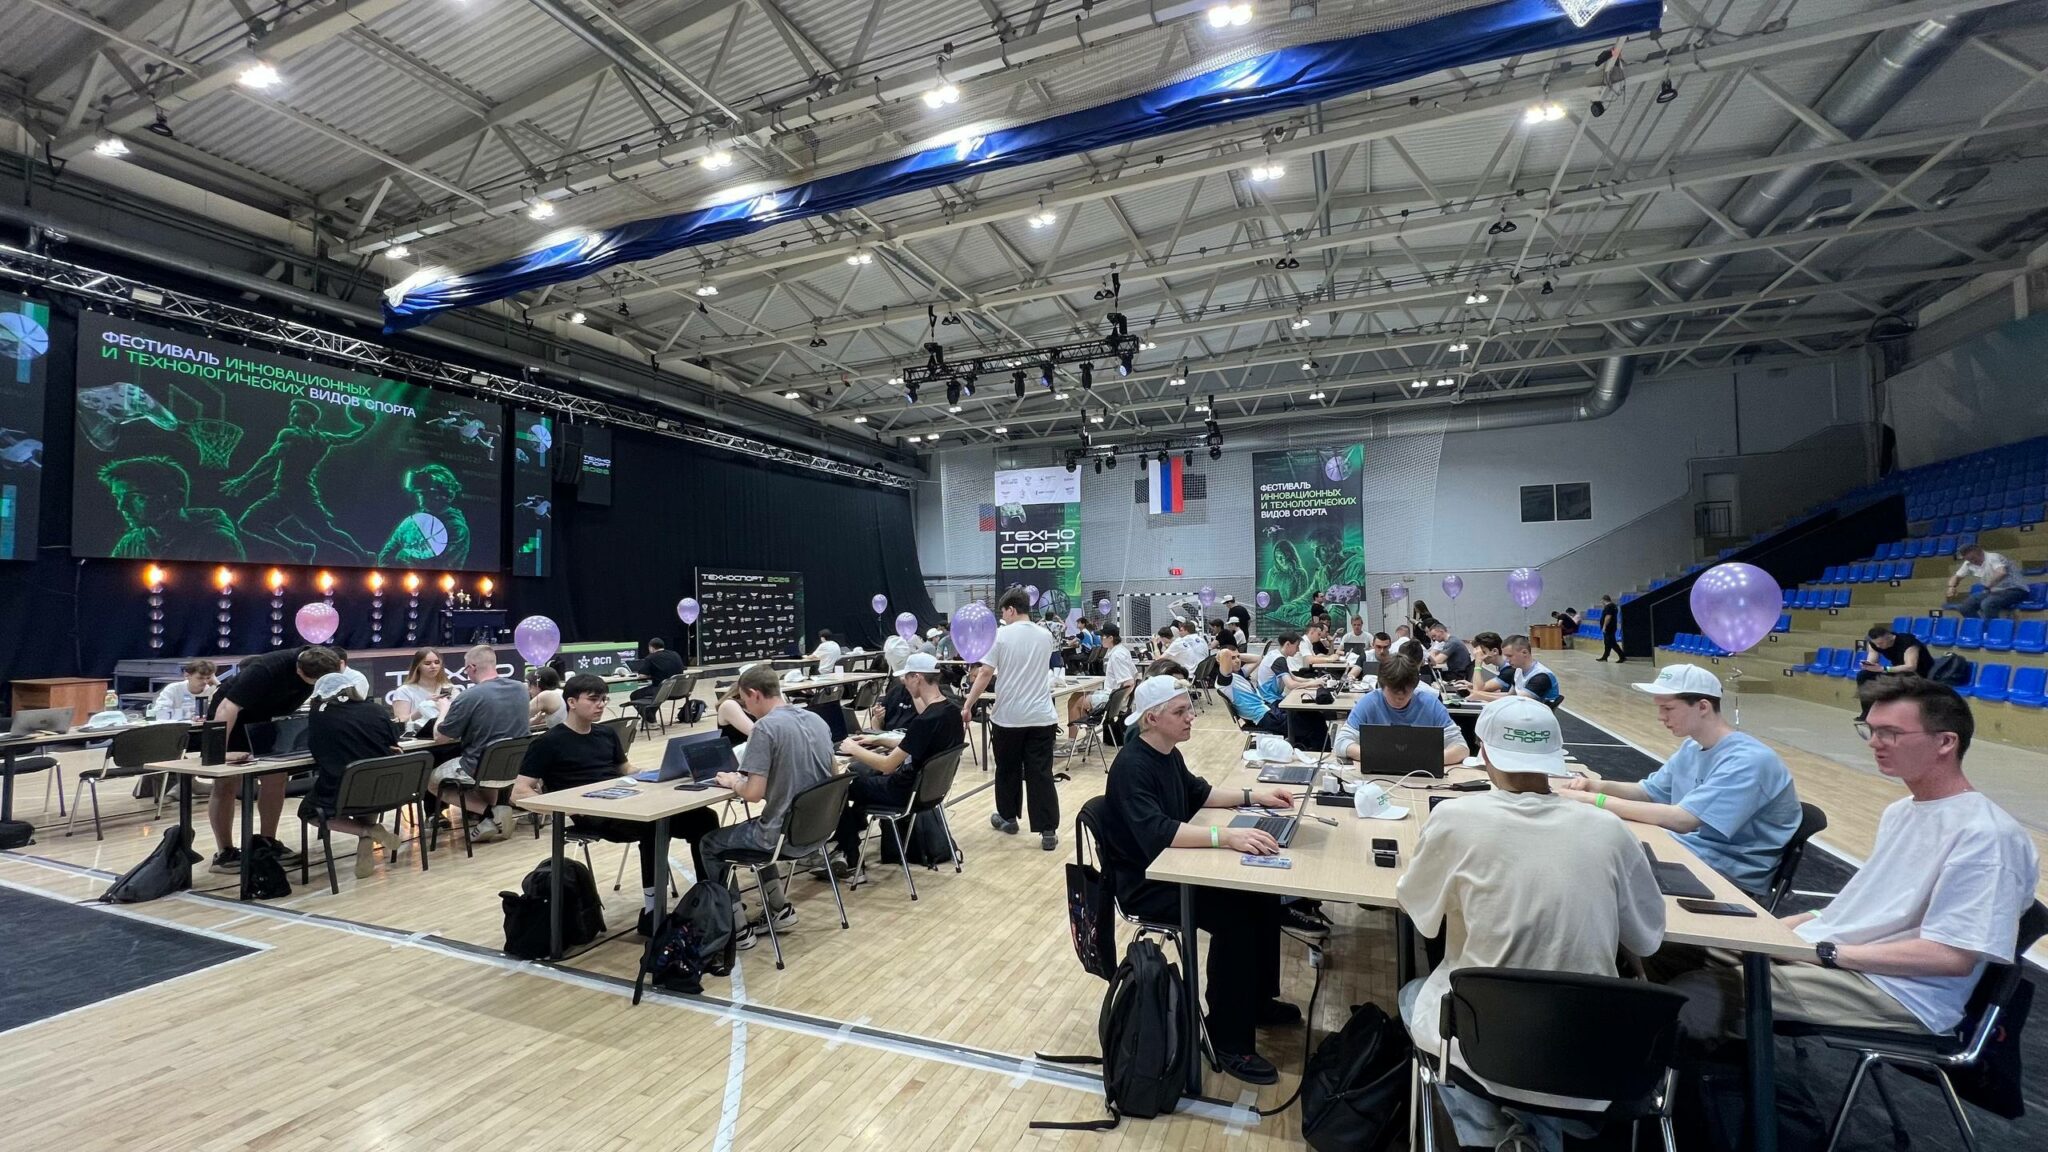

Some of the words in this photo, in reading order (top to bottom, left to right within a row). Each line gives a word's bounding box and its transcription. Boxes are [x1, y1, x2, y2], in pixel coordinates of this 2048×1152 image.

[102, 331, 220, 366] ФЕСТИВАЛЬ
[225, 356, 371, 397] ИННОВАЦИОННЫХ
[102, 345, 118, 360] И
[125, 350, 304, 396] ТЕХНОЛОГИЧЕСКИХ
[309, 387, 360, 407] ВИДОВ
[365, 399, 417, 418] СПОРТА
[1260, 481, 1312, 492] ФЕСТИВАЛЬ
[1260, 488, 1342, 501] ИННОВАЦИОННЫХ
[1261, 501, 1268, 510] И
[1270, 496, 1357, 509] ТЕХНОЛОГИЧЕСКИХ
[1261, 509, 1291, 519] ВИДОВ
[1293, 507, 1328, 517] СПОРТА
[1000, 529, 1076, 542] ТЕХНО
[1000, 541, 1076, 554] СПОРТ
[1001, 556, 1076, 570] 2026
[701, 573, 764, 582] ТЕХНОСПОРТ
[592, 656, 612, 666] ФСП
[1503, 726, 1551, 737] ТЕХНО
[1503, 733, 1550, 744] СПОРТ
